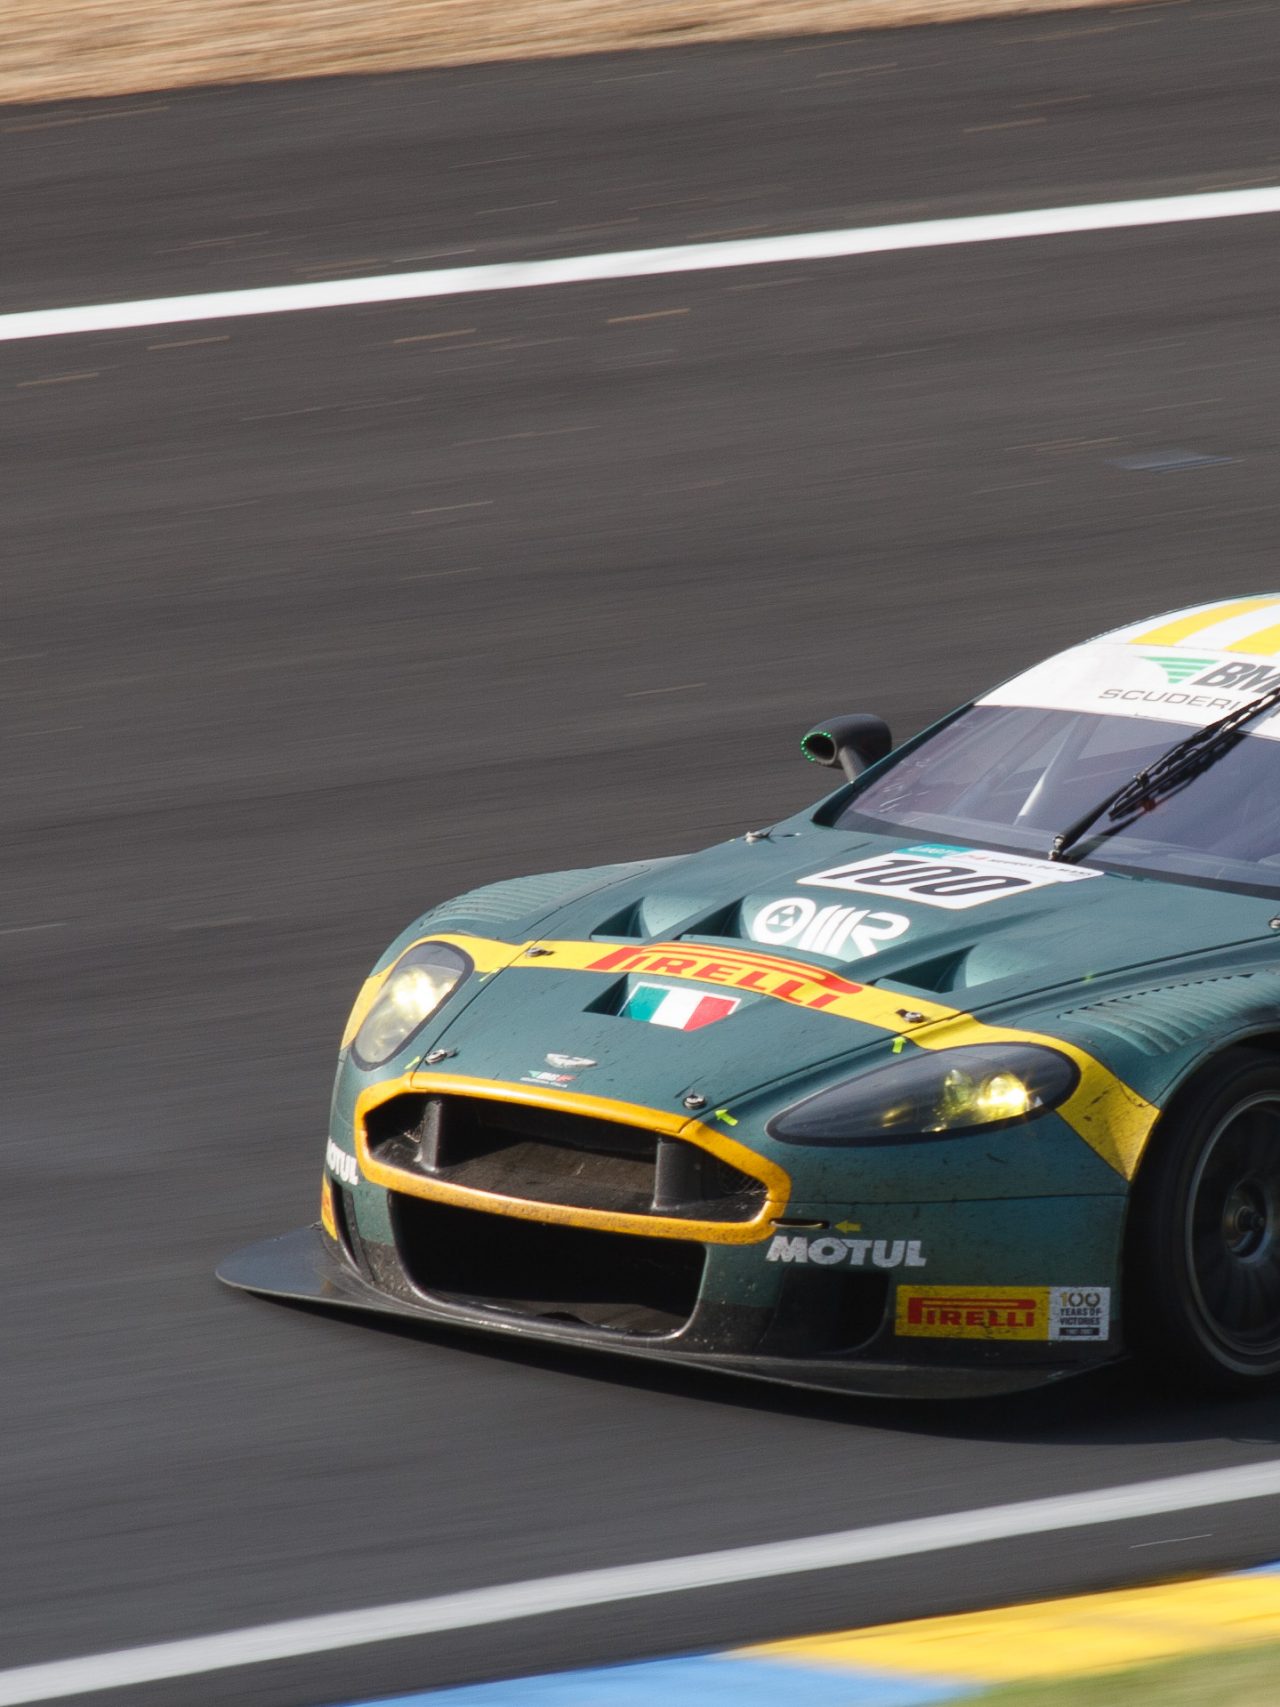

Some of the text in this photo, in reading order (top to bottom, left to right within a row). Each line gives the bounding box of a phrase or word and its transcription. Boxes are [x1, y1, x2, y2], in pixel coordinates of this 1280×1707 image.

[1098, 687, 1242, 712] SCUDERI
[823, 858, 1032, 896] 100
[584, 941, 865, 1010] PIRELLI
[765, 1235, 927, 1268] MOTUL
[907, 1297, 1037, 1328] PIRELLI
[1059, 1292, 1101, 1308] 100
[1060, 1307, 1102, 1316] YEARS OF
[1060, 1316, 1101, 1326] VICTORIES
